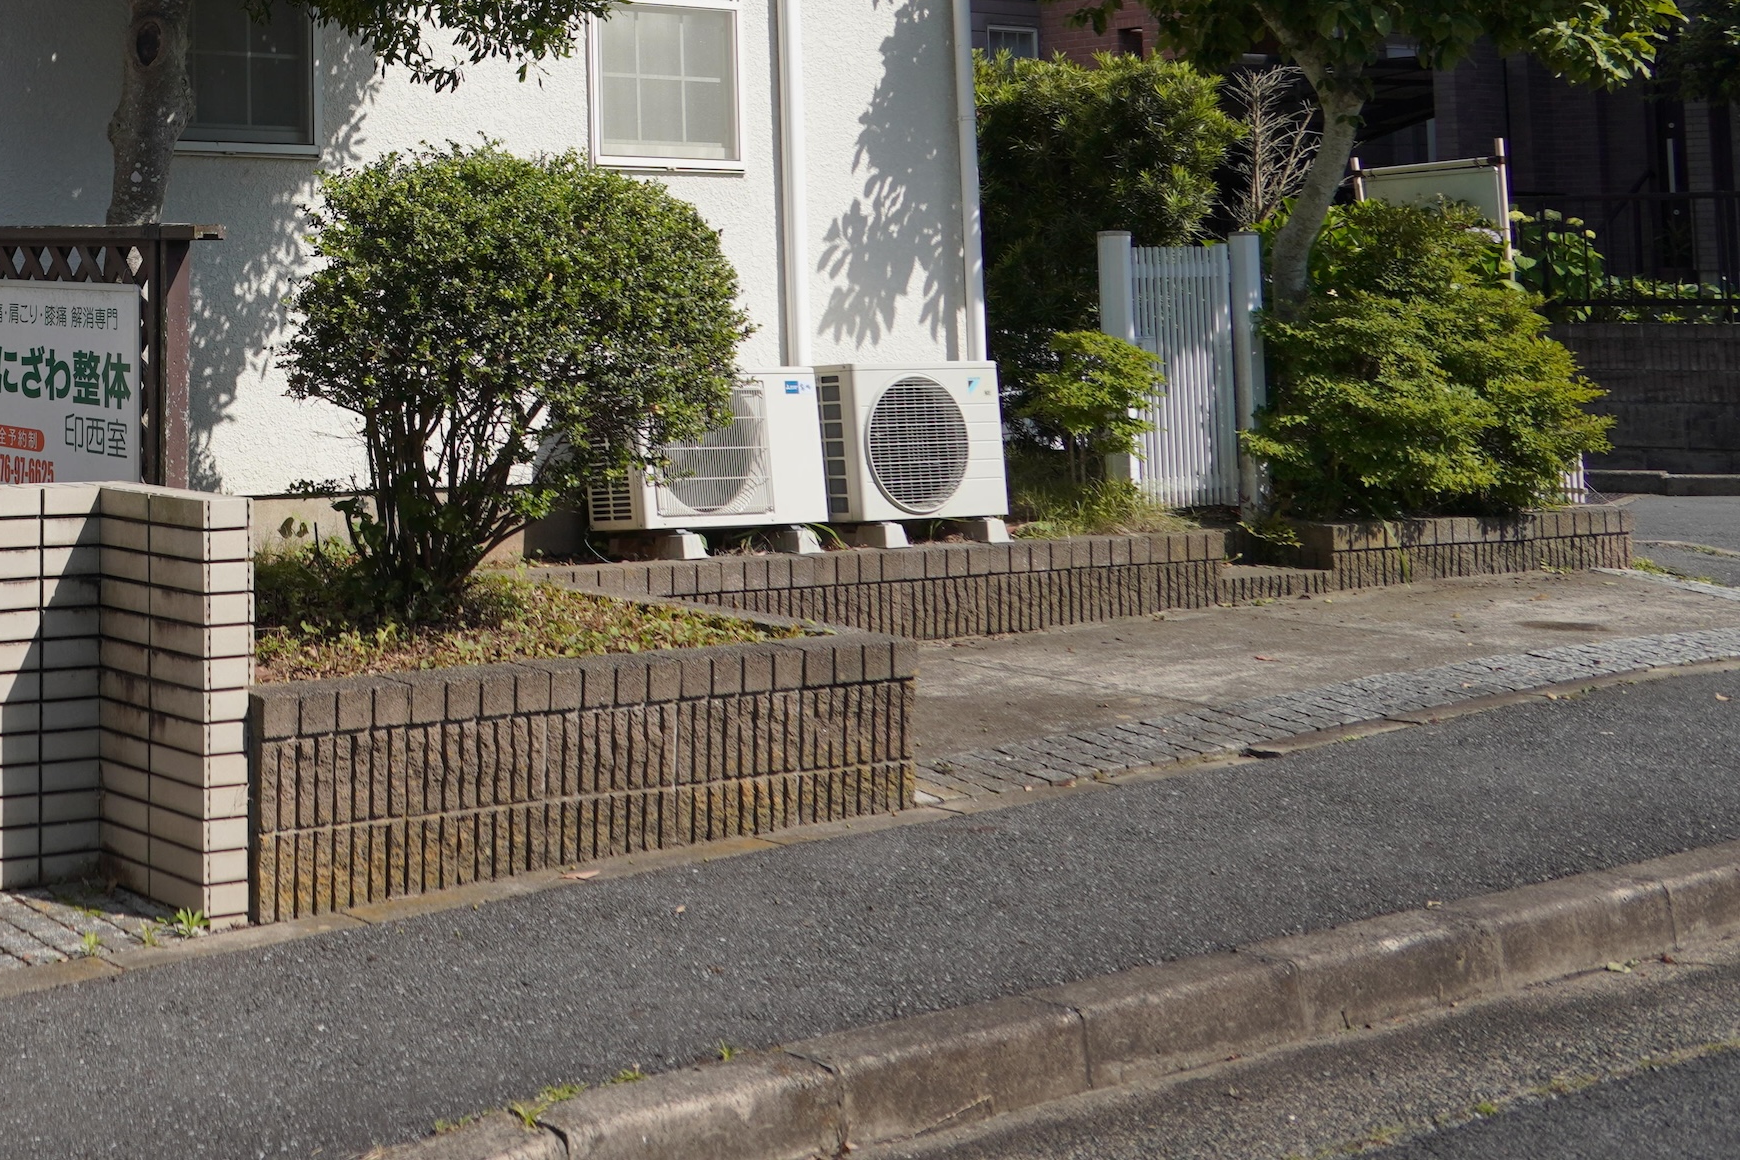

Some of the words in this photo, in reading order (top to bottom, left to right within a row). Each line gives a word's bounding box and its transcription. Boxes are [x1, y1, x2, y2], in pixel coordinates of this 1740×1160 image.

[71, 307, 119, 331] 解消専門
[64, 413, 128, 459] 印西室
